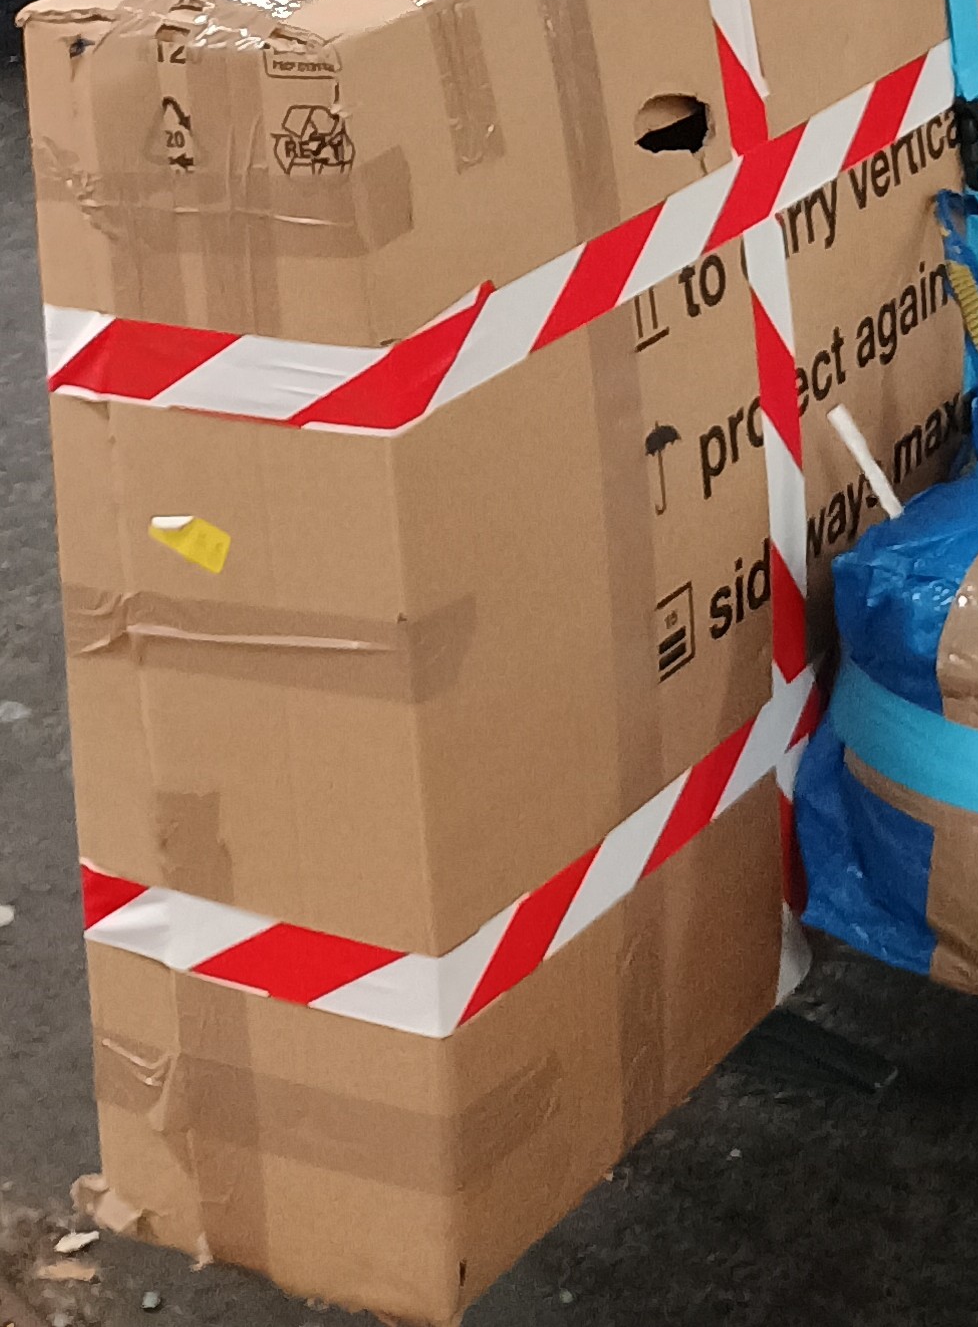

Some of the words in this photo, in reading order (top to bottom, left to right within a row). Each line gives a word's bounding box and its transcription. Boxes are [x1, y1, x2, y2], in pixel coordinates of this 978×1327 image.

[678, 254, 726, 318] to
[700, 326, 846, 500] proect
[856, 261, 949, 365] again
